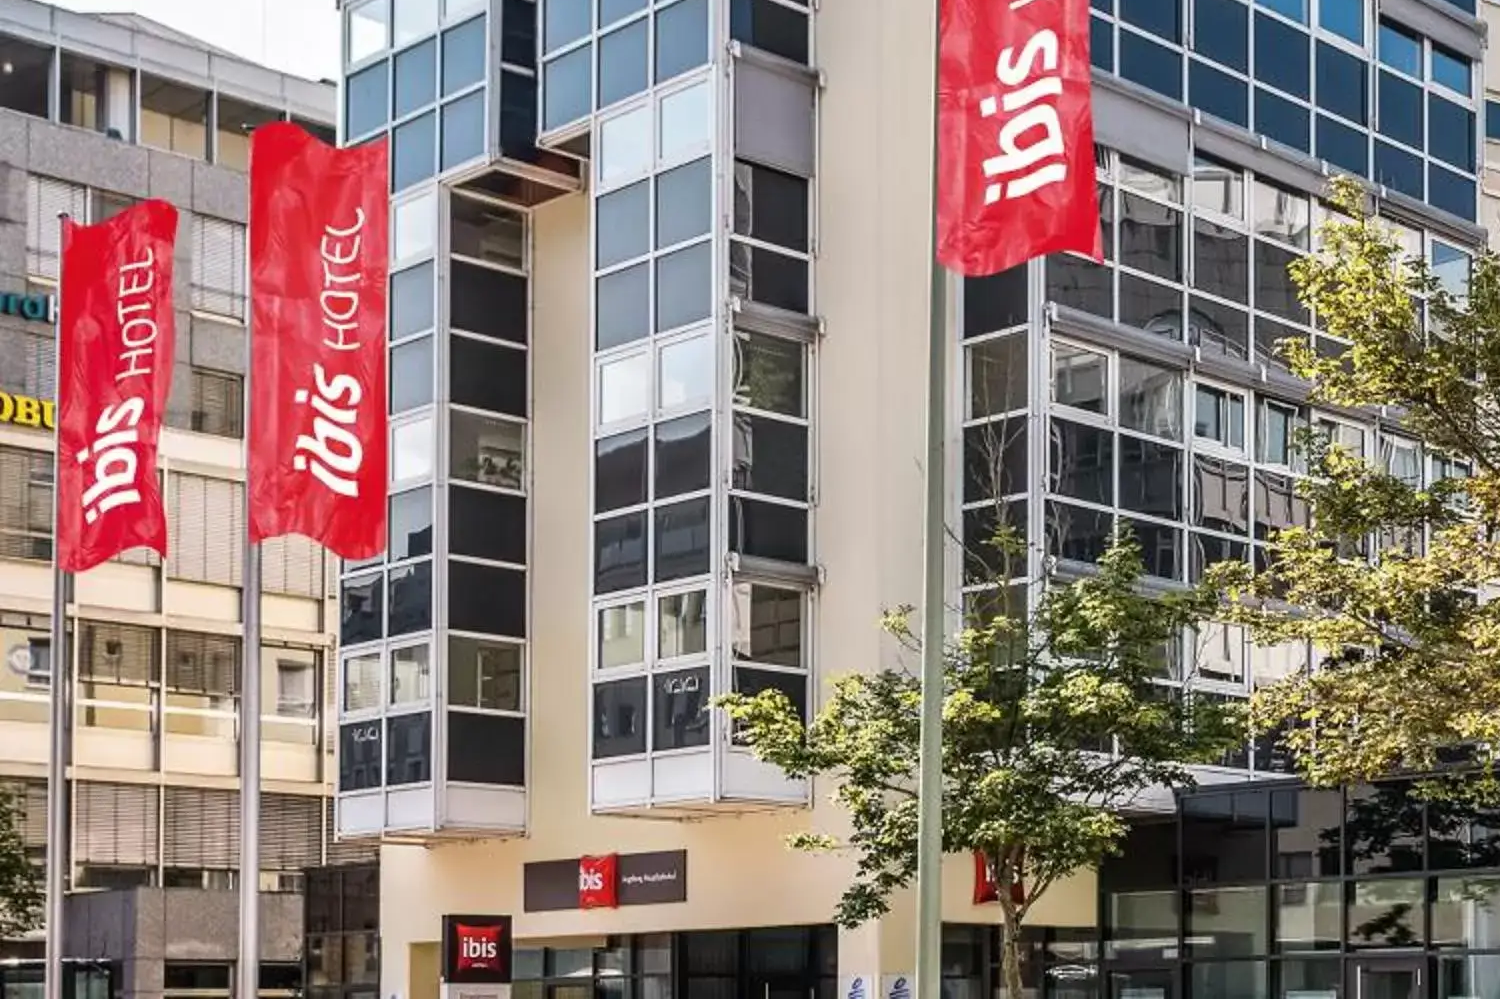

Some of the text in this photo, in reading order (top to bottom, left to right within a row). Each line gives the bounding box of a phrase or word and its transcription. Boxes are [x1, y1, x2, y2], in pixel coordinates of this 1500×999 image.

[979, 29, 1068, 205] ibis
[76, 246, 158, 525] ibis HOTEL
[293, 207, 366, 497] ibis HOTEL
[463, 936, 497, 958] ibis
